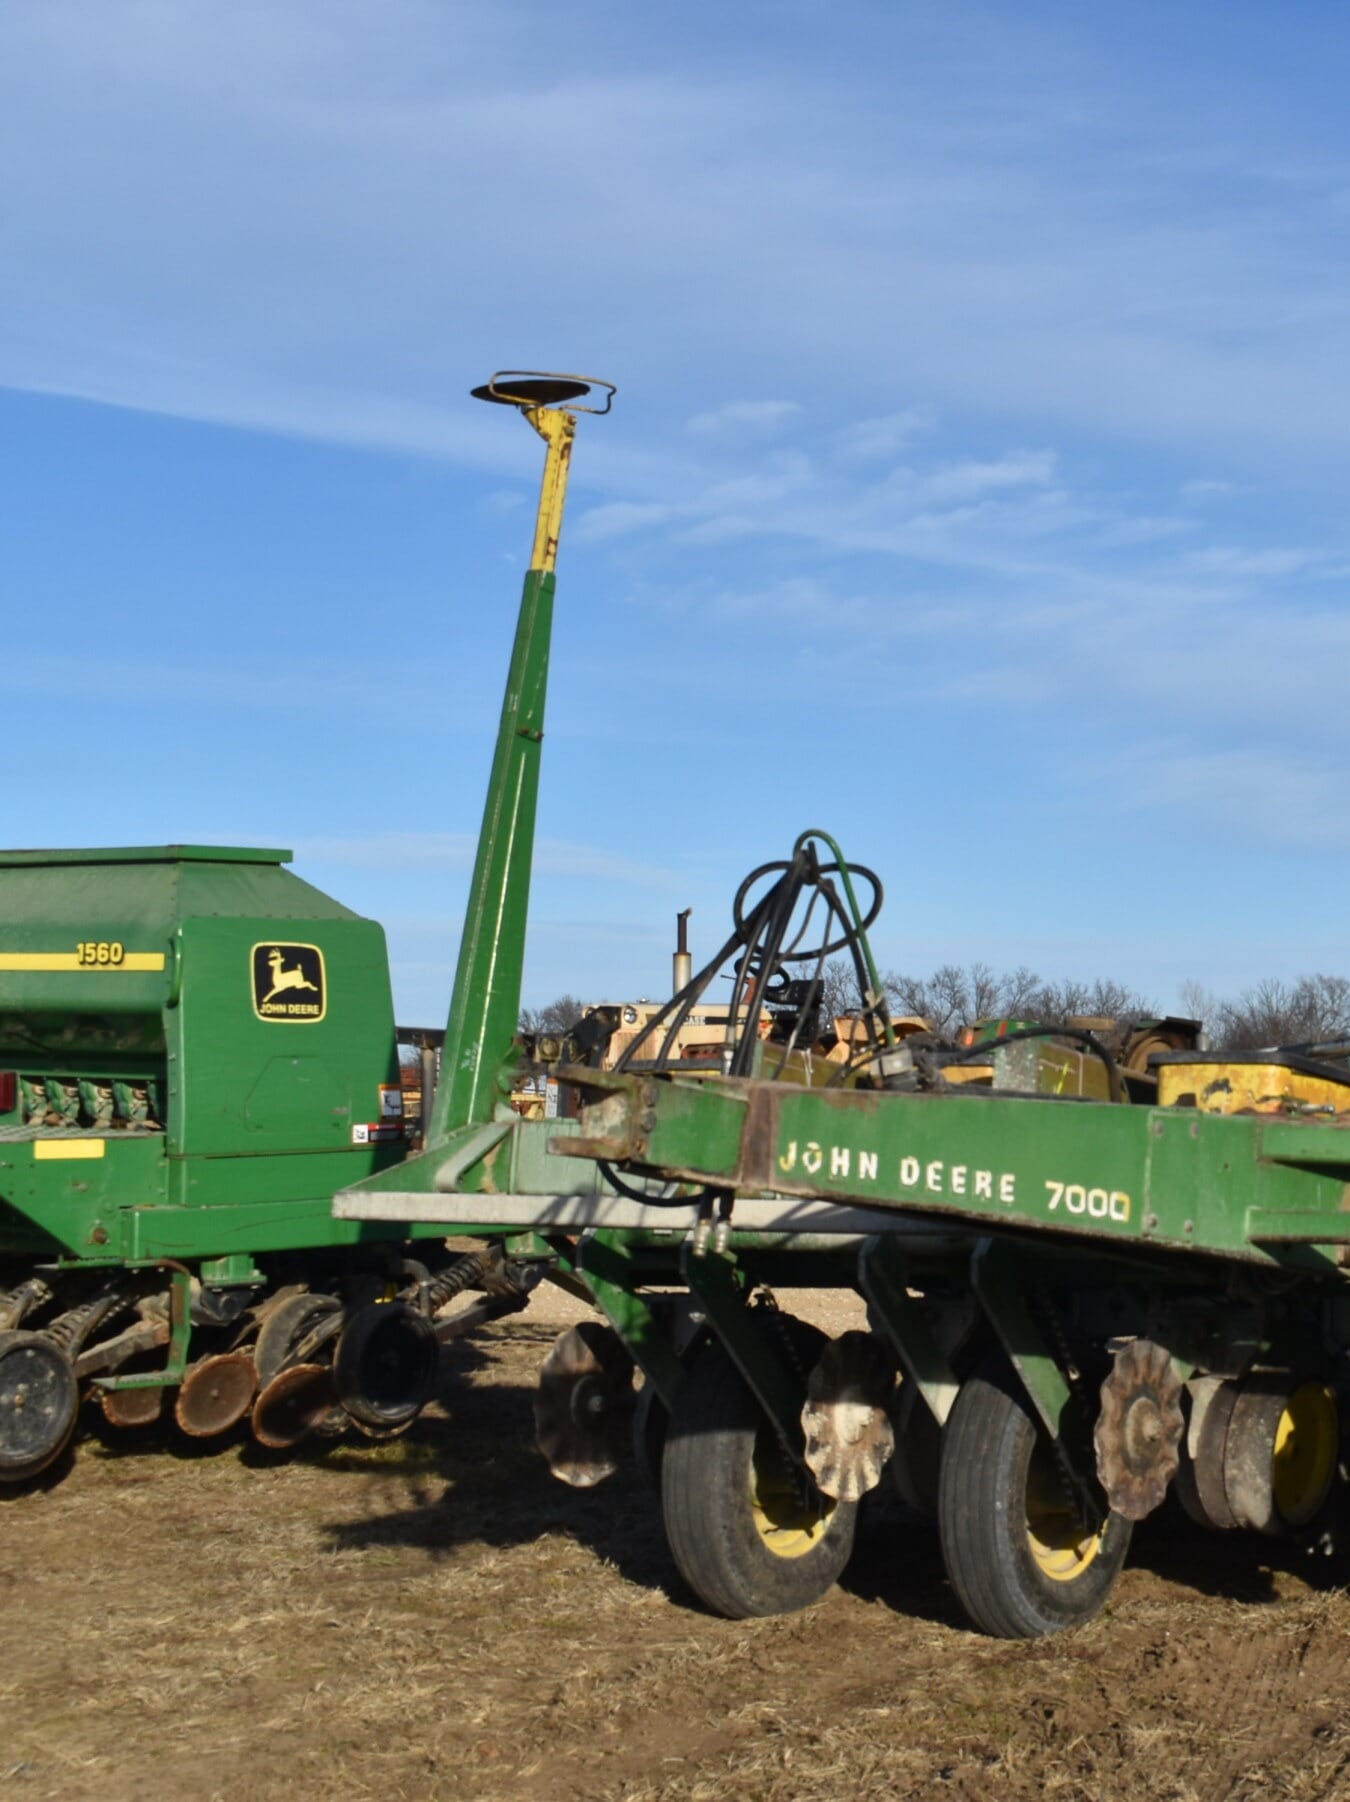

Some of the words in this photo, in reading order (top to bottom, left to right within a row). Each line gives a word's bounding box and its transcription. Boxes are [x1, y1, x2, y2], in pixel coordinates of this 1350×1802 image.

[77, 942, 124, 966] 1560
[260, 1003, 287, 1014] JOHN
[288, 1004, 320, 1015] DEERE
[779, 1141, 879, 1180] JOHN
[899, 1155, 1016, 1202] DEERE
[1045, 1179, 1131, 1223] 7000
